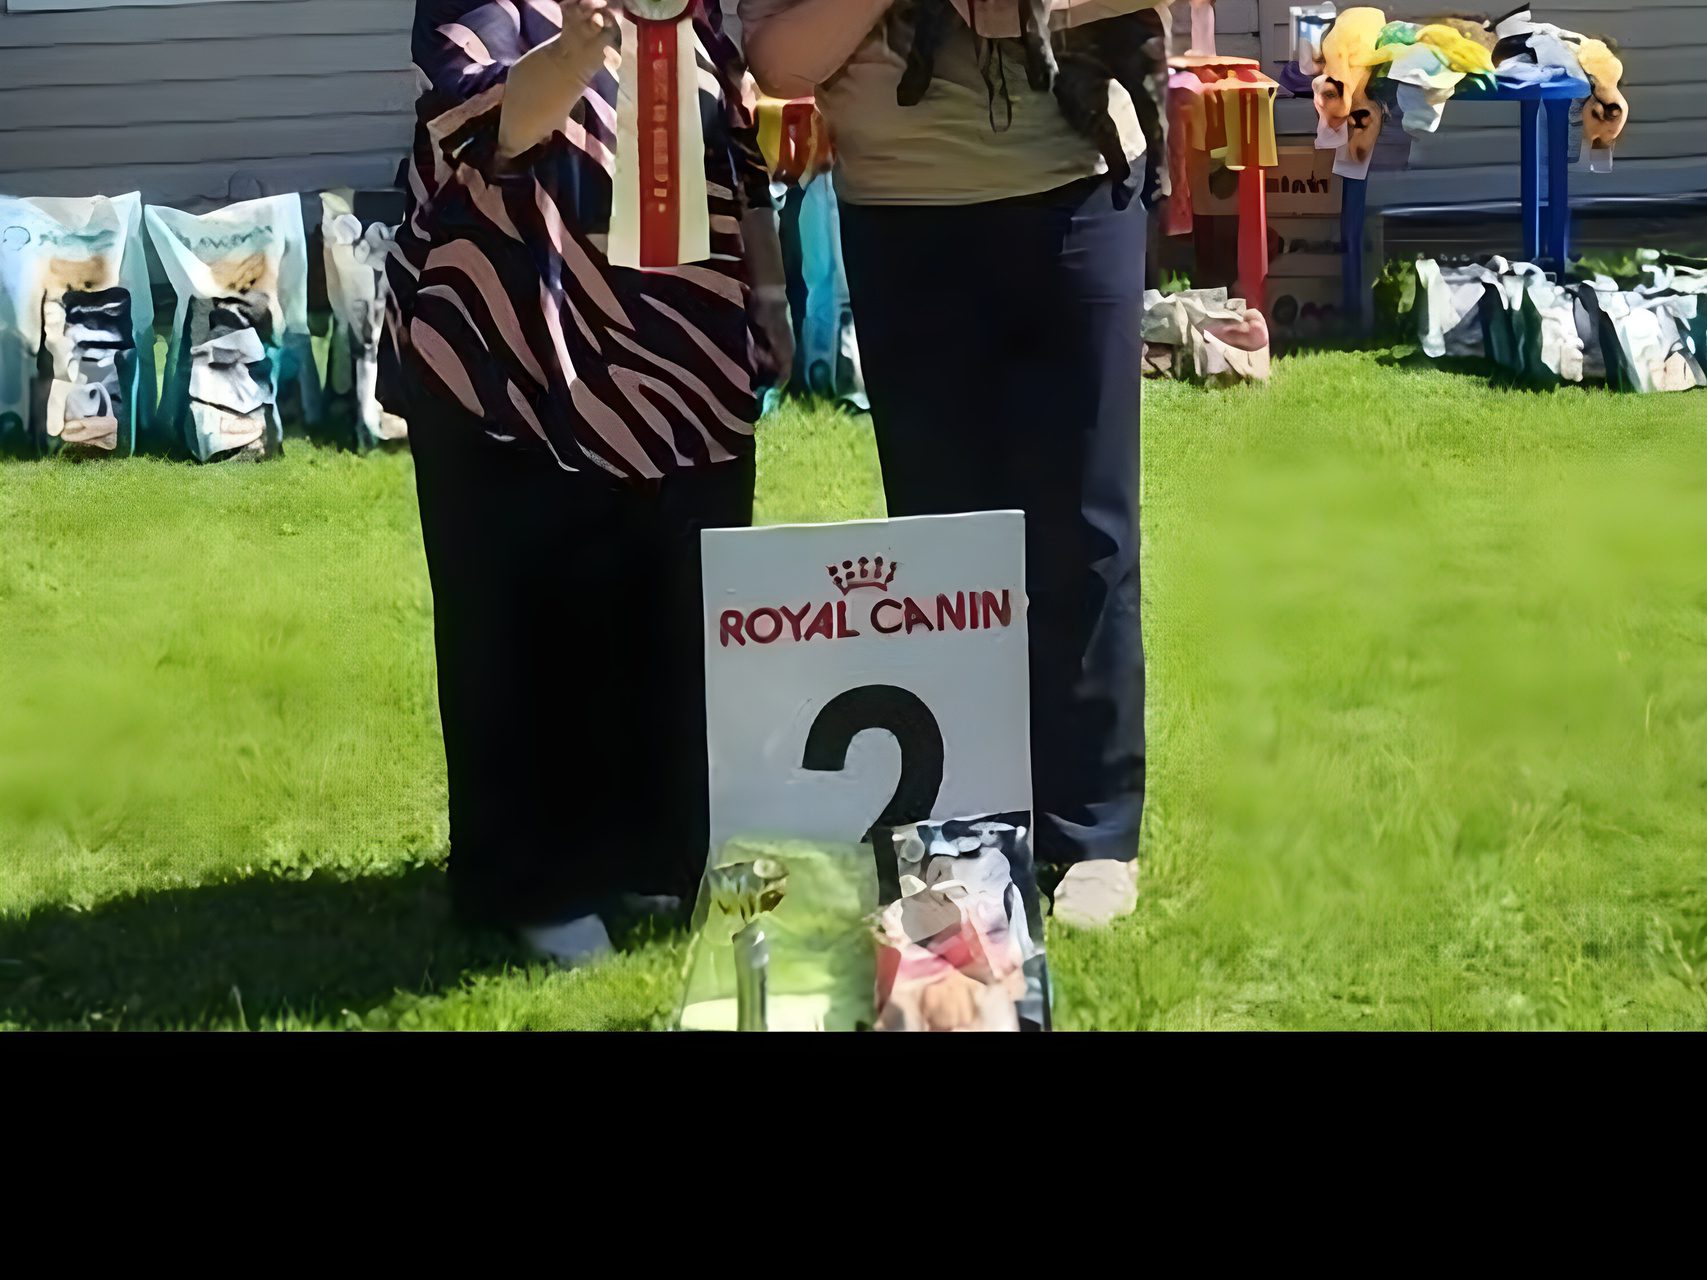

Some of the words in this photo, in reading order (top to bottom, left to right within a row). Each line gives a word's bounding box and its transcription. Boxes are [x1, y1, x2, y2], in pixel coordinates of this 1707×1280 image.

[719, 600, 861, 648] ROYAL
[869, 589, 1012, 635] CANIN
[801, 683, 945, 850] 2
